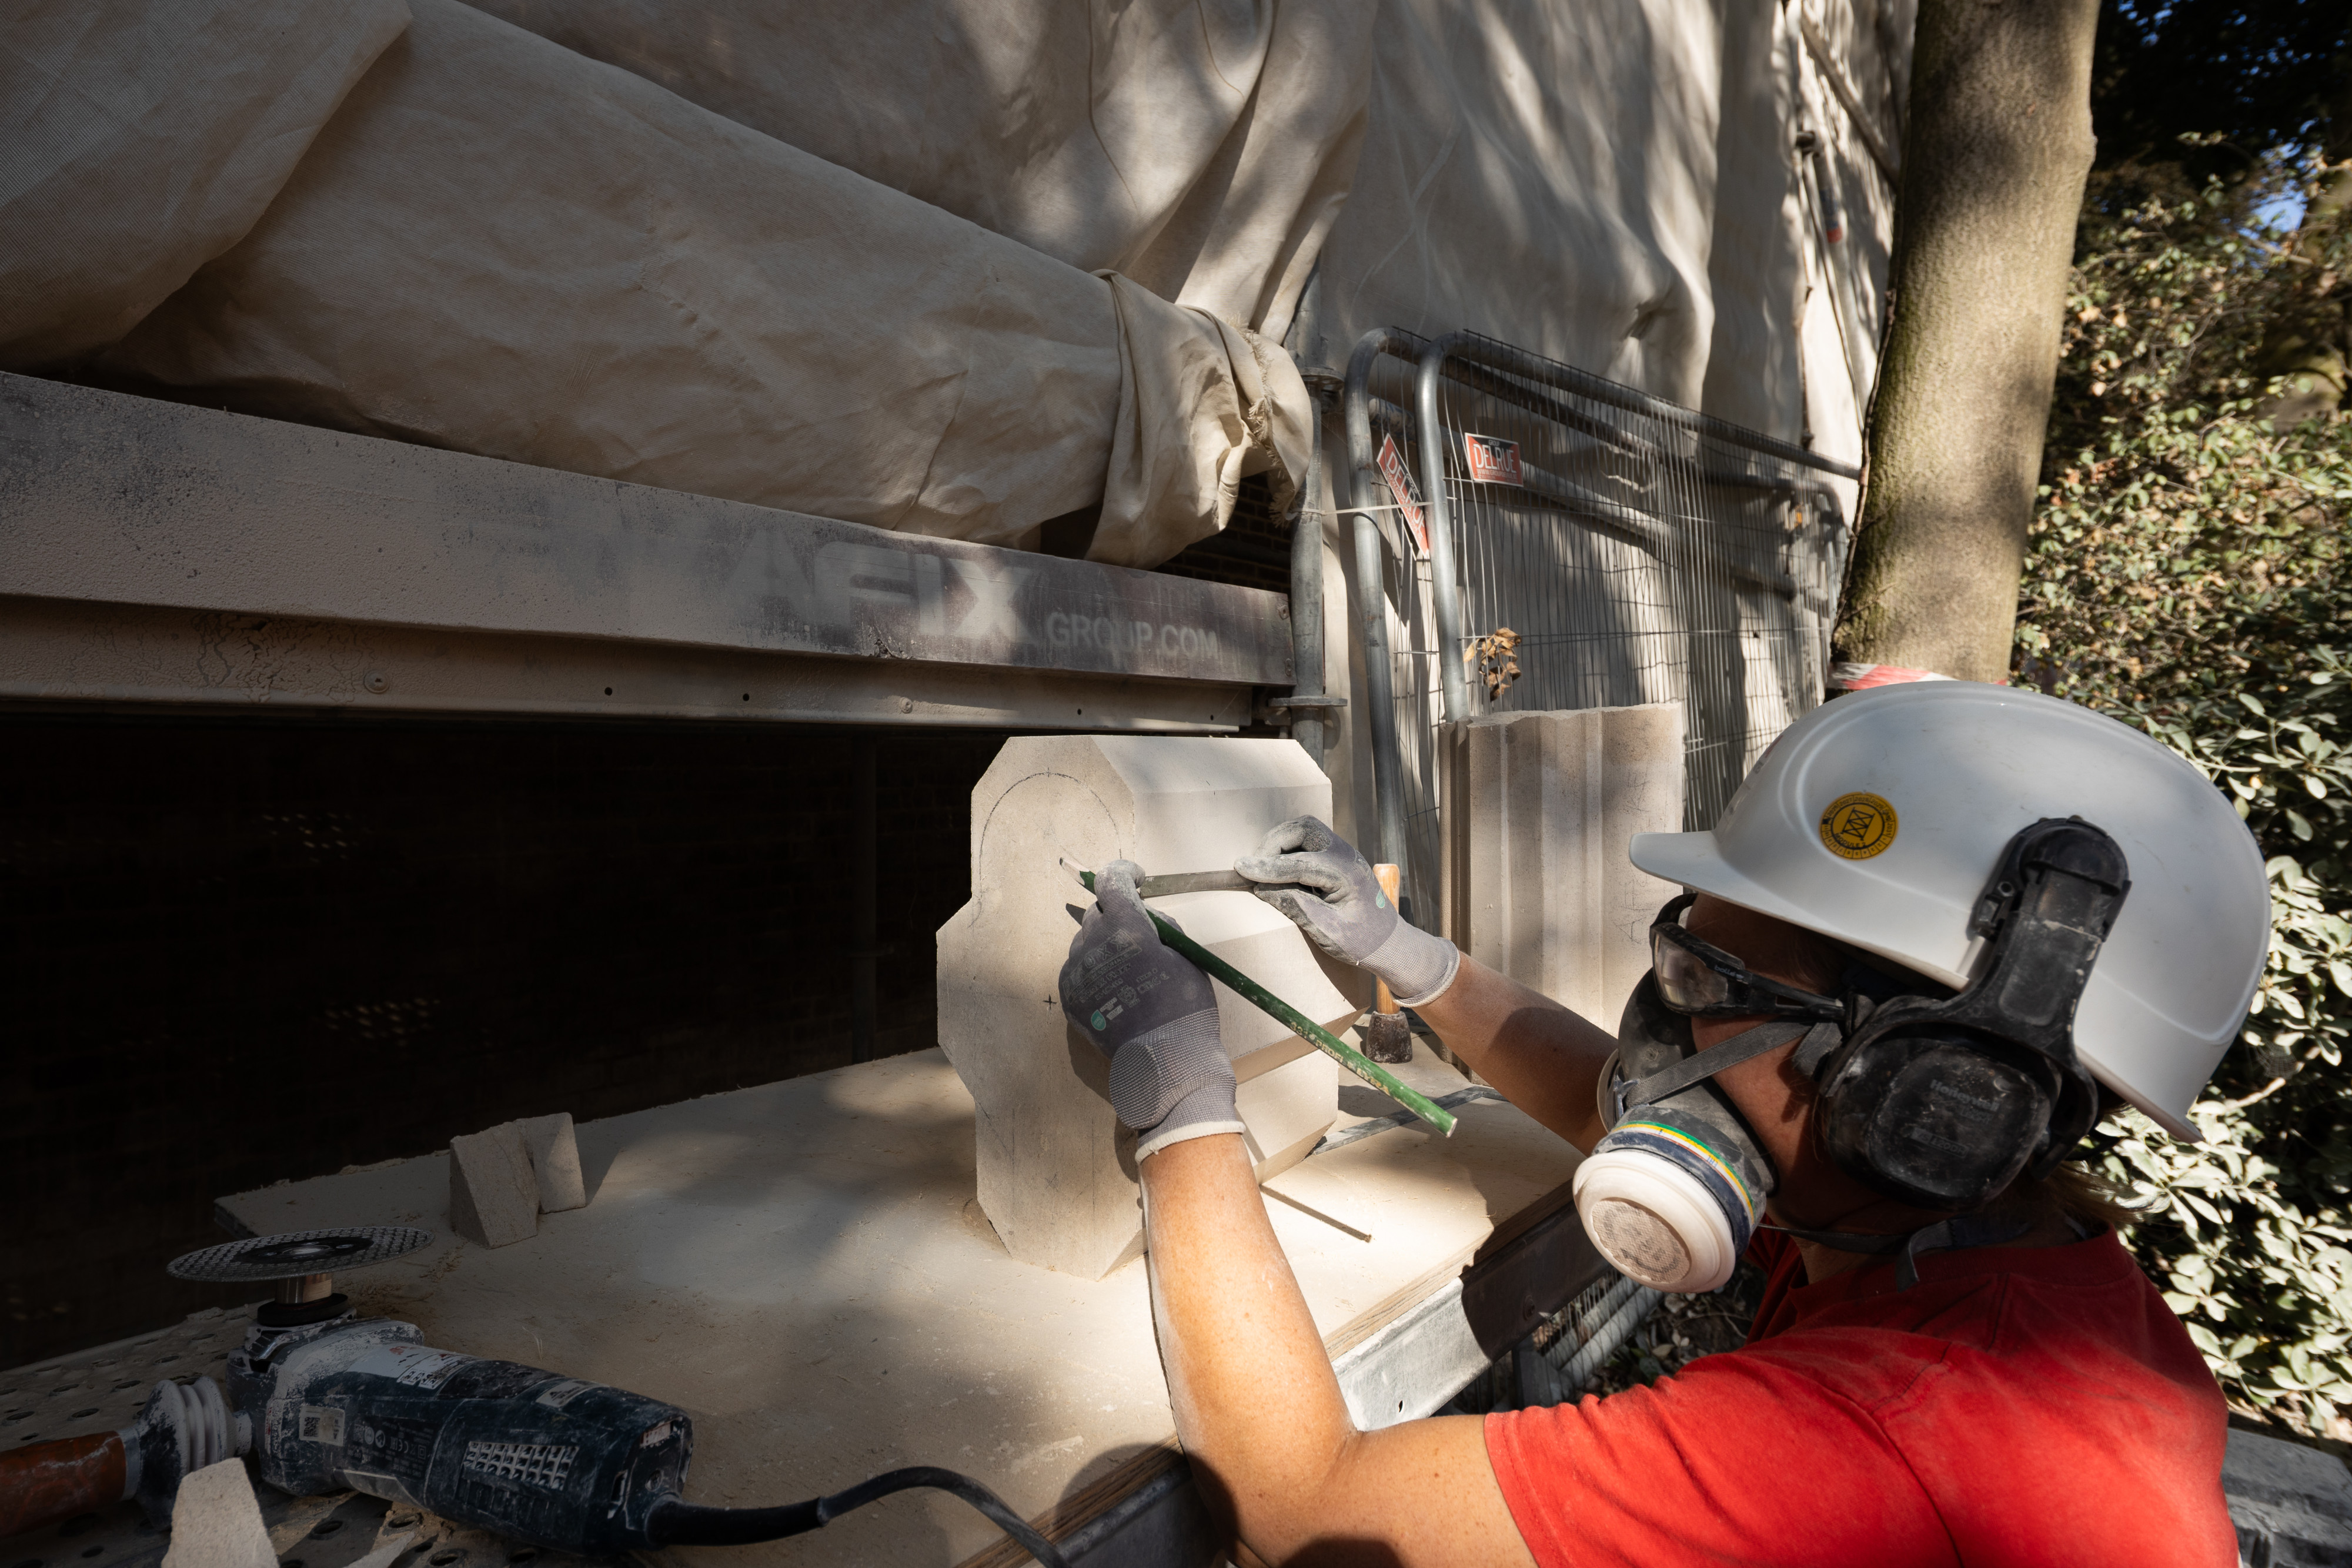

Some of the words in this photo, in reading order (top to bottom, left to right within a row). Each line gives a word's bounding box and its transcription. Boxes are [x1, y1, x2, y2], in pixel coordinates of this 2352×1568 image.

[1473, 443, 1516, 473] DELRUE
[1387, 450, 1425, 538] DELRUE
[1406, 473, 1418, 494] GROUP
[727, 530, 1037, 644] AFIX
[1046, 613, 1219, 658] GROUP.COM
[1833, 832, 1860, 848] MODULE
[1315, 1039, 1344, 1063] PROFI
[1930, 1079, 2000, 1112] Honeywell
